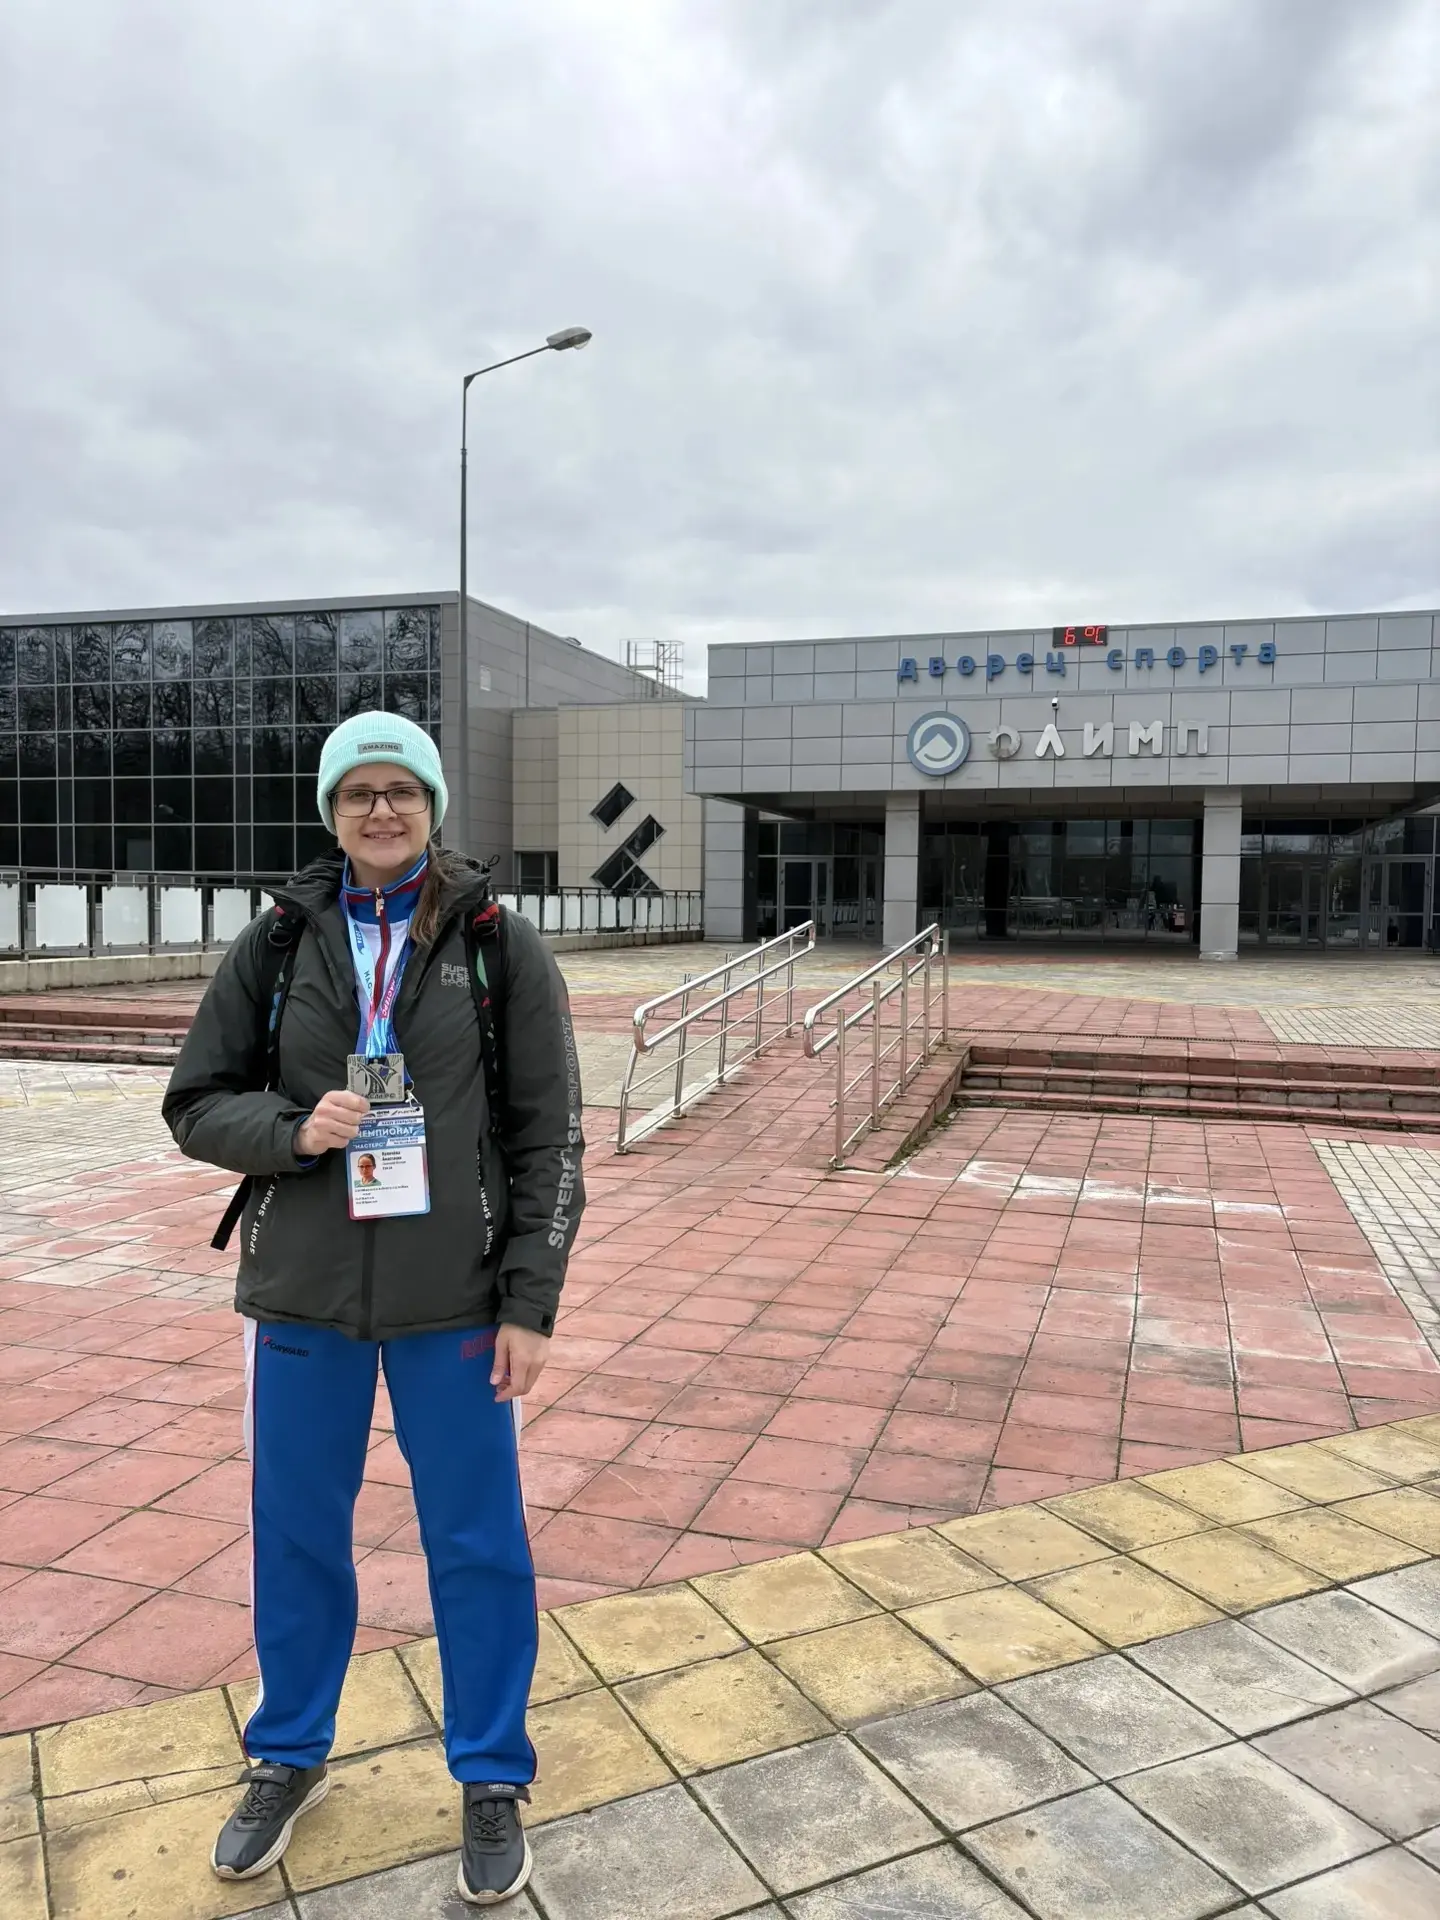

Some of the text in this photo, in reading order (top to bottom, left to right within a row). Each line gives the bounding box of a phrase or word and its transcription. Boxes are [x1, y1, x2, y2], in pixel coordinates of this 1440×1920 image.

[1064, 627, 1076, 645] 6
[897, 641, 1277, 682] дворец спорта
[362, 743, 399, 751] AMAZING
[988, 719, 1209, 758] ОЛИМП
[440, 978, 471, 989] SPOR
[561, 1017, 578, 1106] SPORT
[249, 1184, 276, 1255] SPORT SPORT
[480, 1187, 494, 1256] SPORT SPORT
